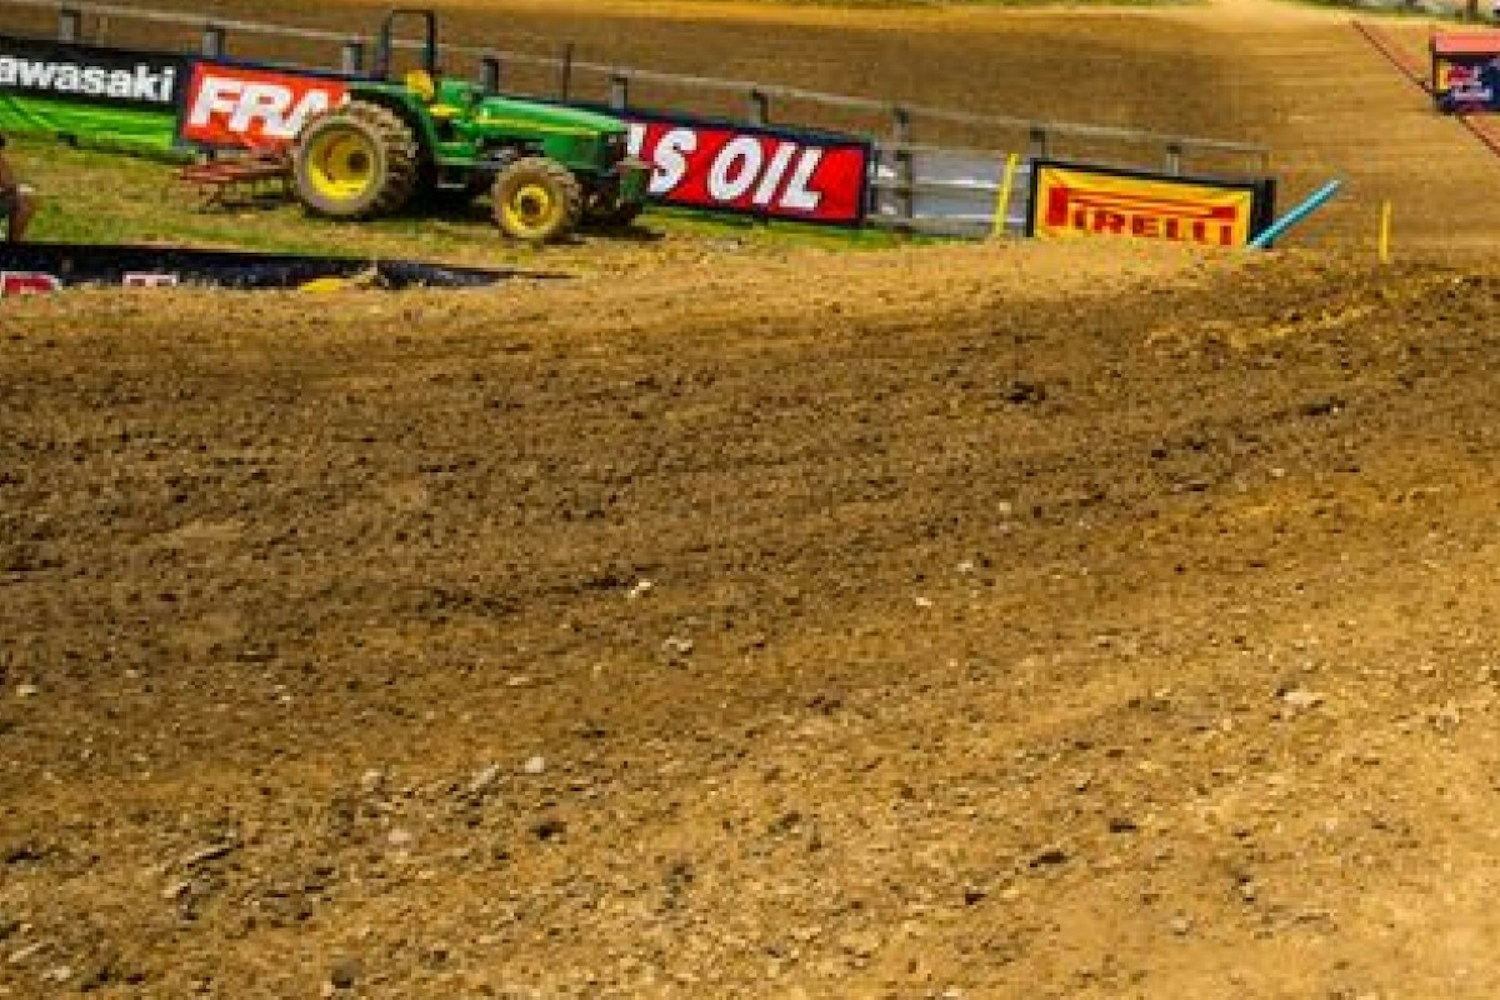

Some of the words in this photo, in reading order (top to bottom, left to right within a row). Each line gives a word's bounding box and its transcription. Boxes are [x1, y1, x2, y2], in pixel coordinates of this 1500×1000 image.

[189, 76, 350, 138] FRA
[708, 136, 822, 210] OIL
[1046, 186, 1236, 246] PIRELLI
